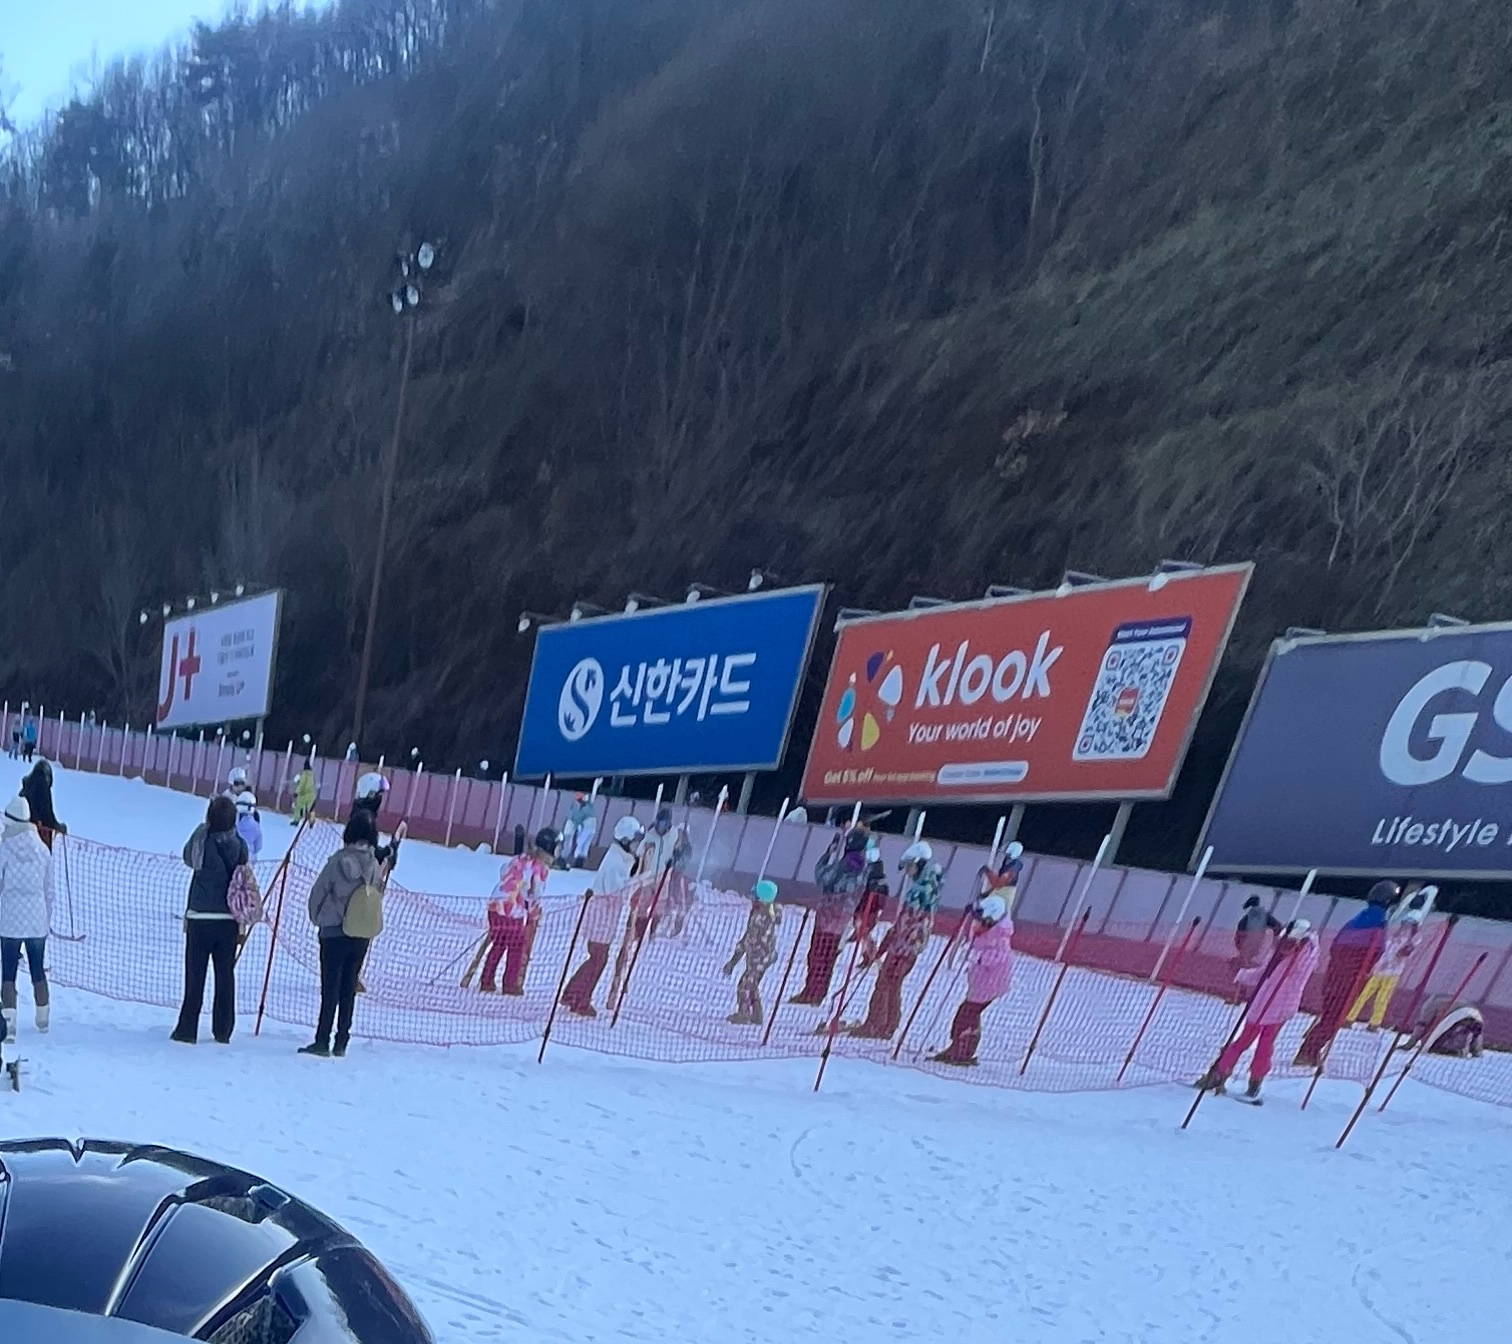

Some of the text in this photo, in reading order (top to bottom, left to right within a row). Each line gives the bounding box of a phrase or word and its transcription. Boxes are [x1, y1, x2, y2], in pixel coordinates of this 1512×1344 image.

[609, 652, 757, 728] 신한카드
[914, 629, 1065, 711] klook
[908, 714, 1043, 744] Your world of joy
[1371, 816, 1499, 852] Lifestyle
